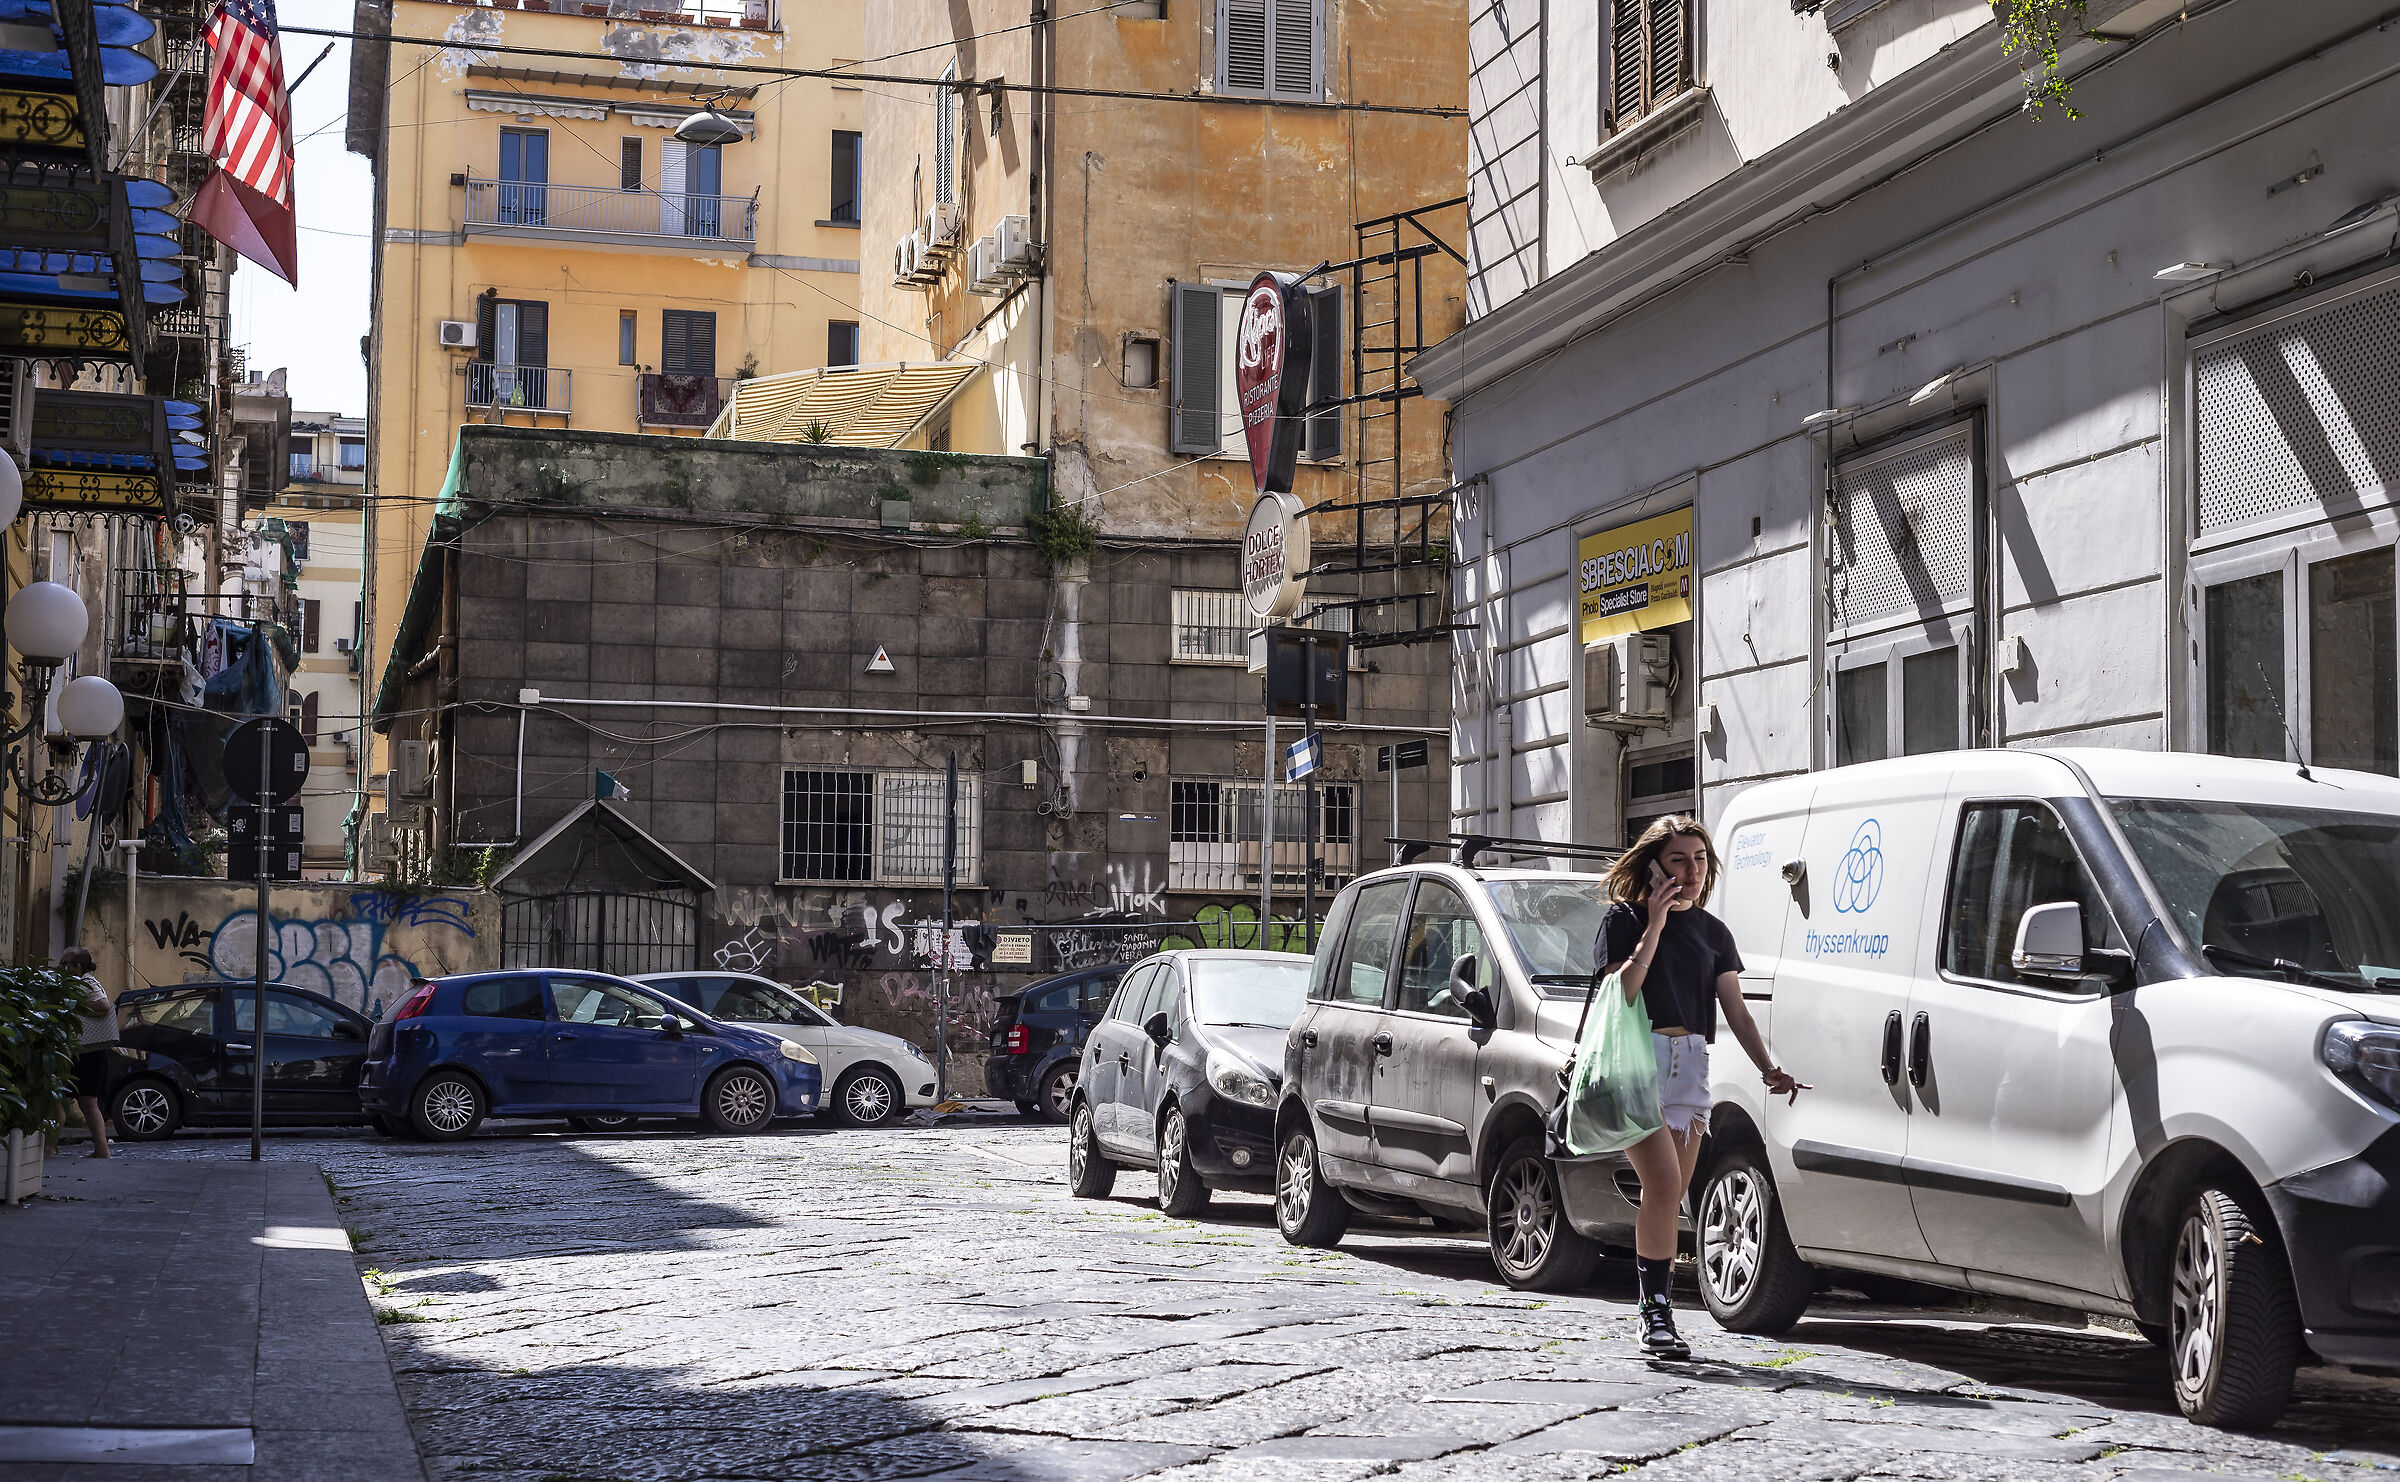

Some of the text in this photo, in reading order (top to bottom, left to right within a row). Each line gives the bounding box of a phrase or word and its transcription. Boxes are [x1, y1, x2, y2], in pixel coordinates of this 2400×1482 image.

[1243, 373, 1279, 408] RISTORANTE
[1247, 400, 1275, 429] PIZZERIA
[1249, 525, 1279, 555] DOLCE
[1582, 589, 1648, 617] Photo Specialist Store
[1736, 832, 1766, 851] Elevator
[1733, 850, 1774, 872] Technology
[1123, 933, 1149, 943] SANTA
[1805, 928, 1889, 960] thyssenkrupp
[1120, 951, 1144, 961] VERA
